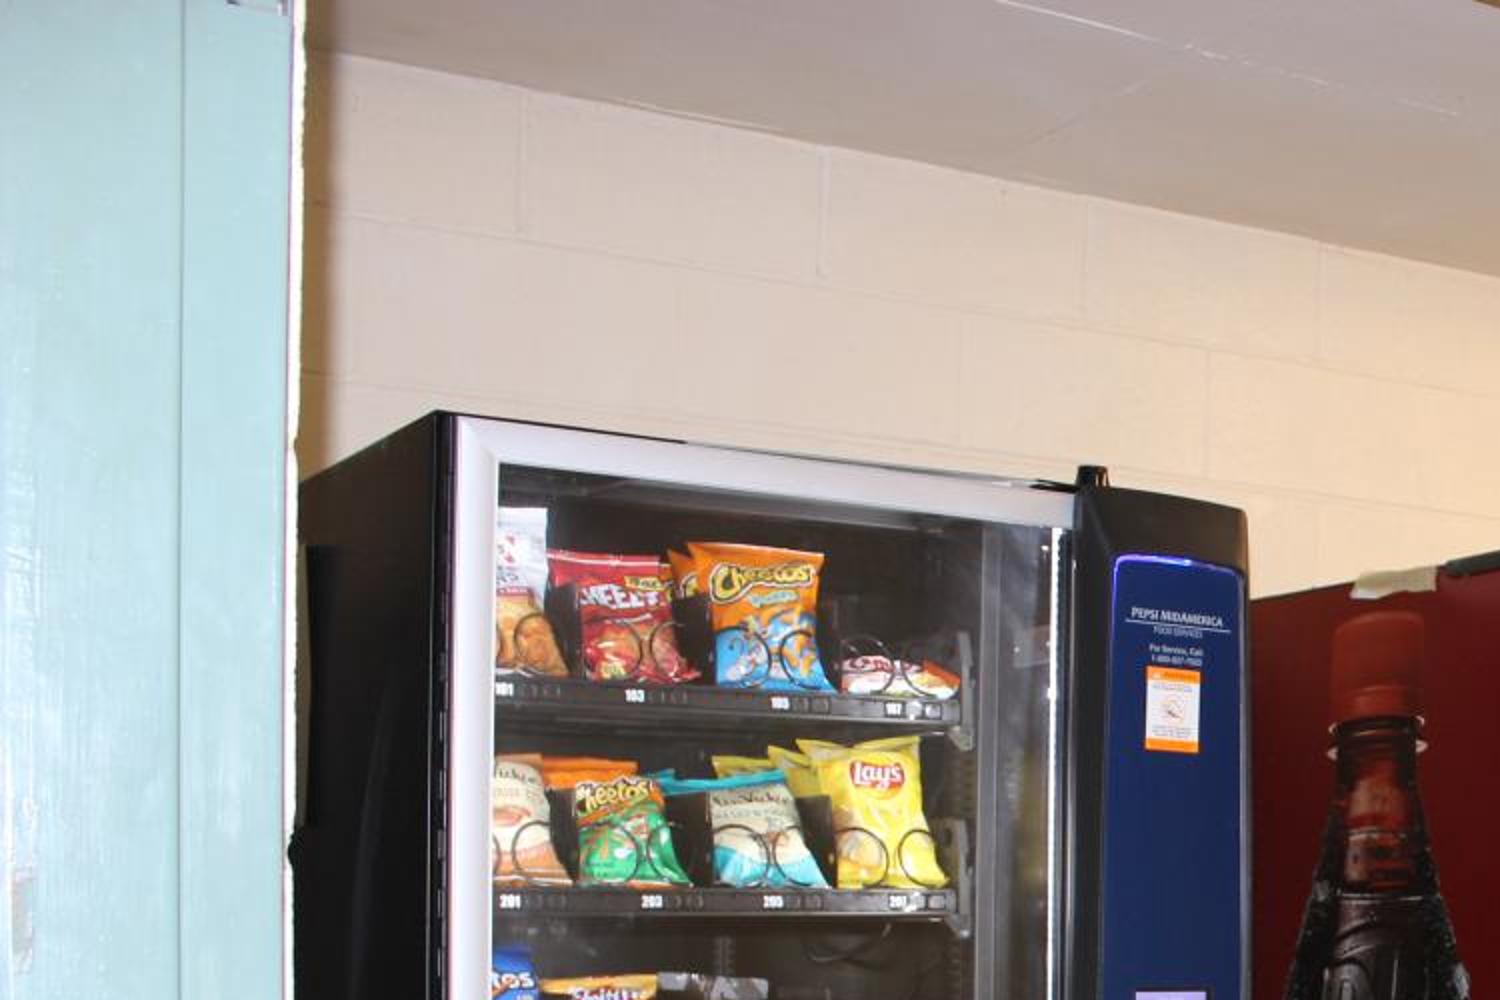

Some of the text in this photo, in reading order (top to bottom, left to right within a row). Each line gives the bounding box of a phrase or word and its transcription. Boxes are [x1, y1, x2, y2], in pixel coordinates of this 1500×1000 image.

[710, 564, 813, 603] Cheetos
[626, 689, 645, 702] 103
[500, 894, 521, 909] 201
[642, 896, 662, 909] 203
[763, 896, 784, 908] 205
